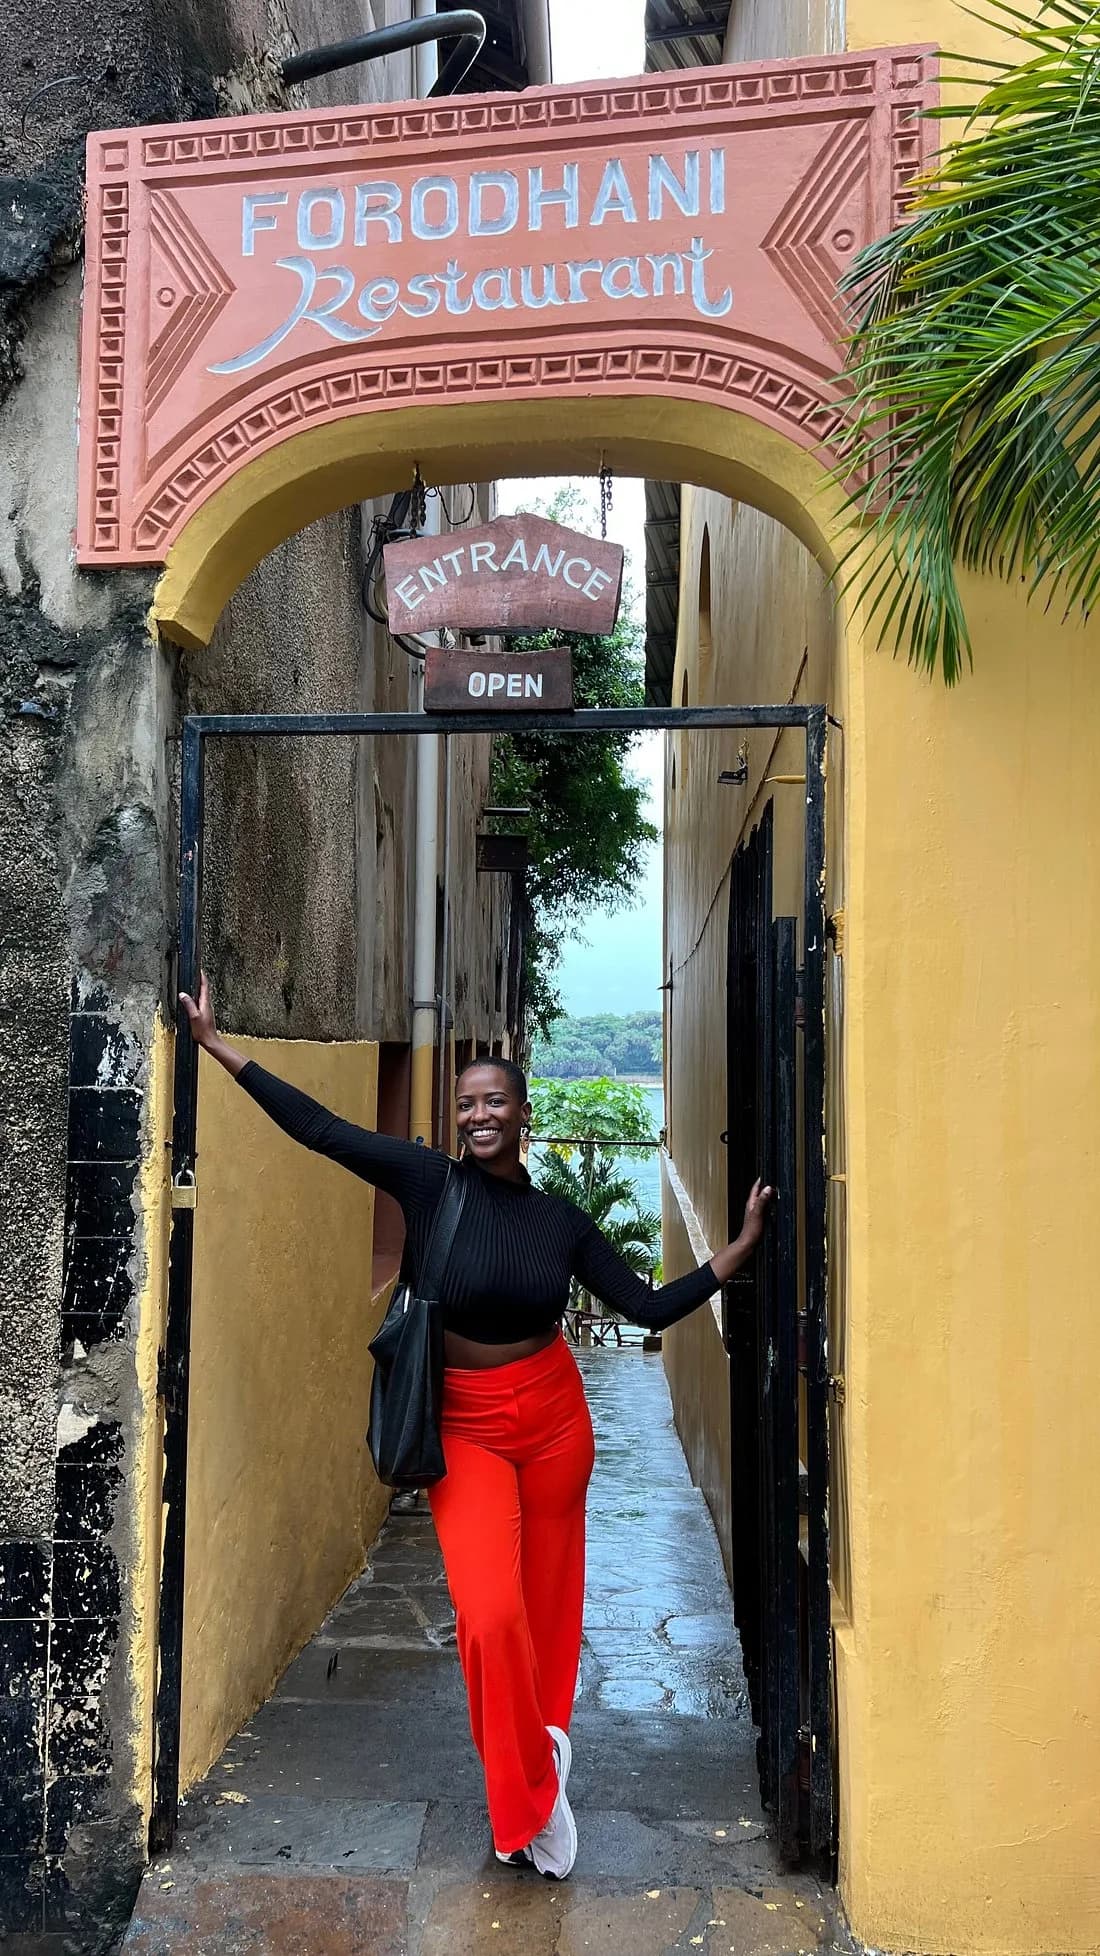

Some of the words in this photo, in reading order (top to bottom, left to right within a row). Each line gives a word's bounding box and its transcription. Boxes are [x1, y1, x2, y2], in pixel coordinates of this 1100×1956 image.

[242, 147, 726, 256] FORODHANI
[206, 236, 733, 374] Restaurant
[394, 538, 613, 610] ENTRANCE
[468, 671, 543, 697] OPEN
